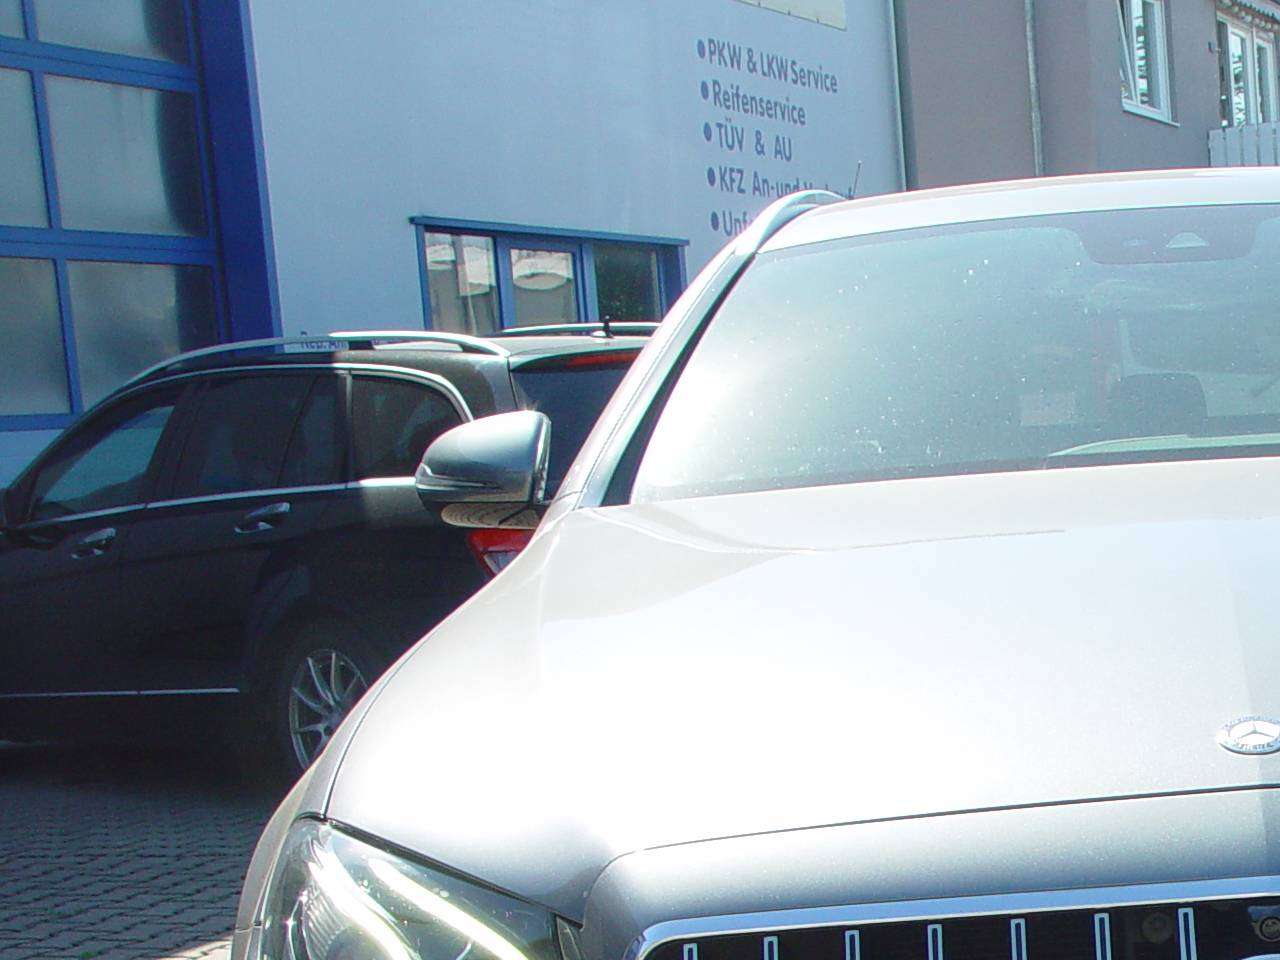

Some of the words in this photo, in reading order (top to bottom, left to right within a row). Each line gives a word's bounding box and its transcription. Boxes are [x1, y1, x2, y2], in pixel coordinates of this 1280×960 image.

[707, 38, 742, 71] PKW
[746, 48, 758, 74] &
[760, 52, 788, 83] LKW
[790, 60, 838, 93] Service
[712, 79, 806, 126] Reifenservice
[715, 117, 745, 152] TÜV
[755, 130, 766, 157] &
[774, 135, 792, 162] AU
[718, 165, 746, 194] KFZ
